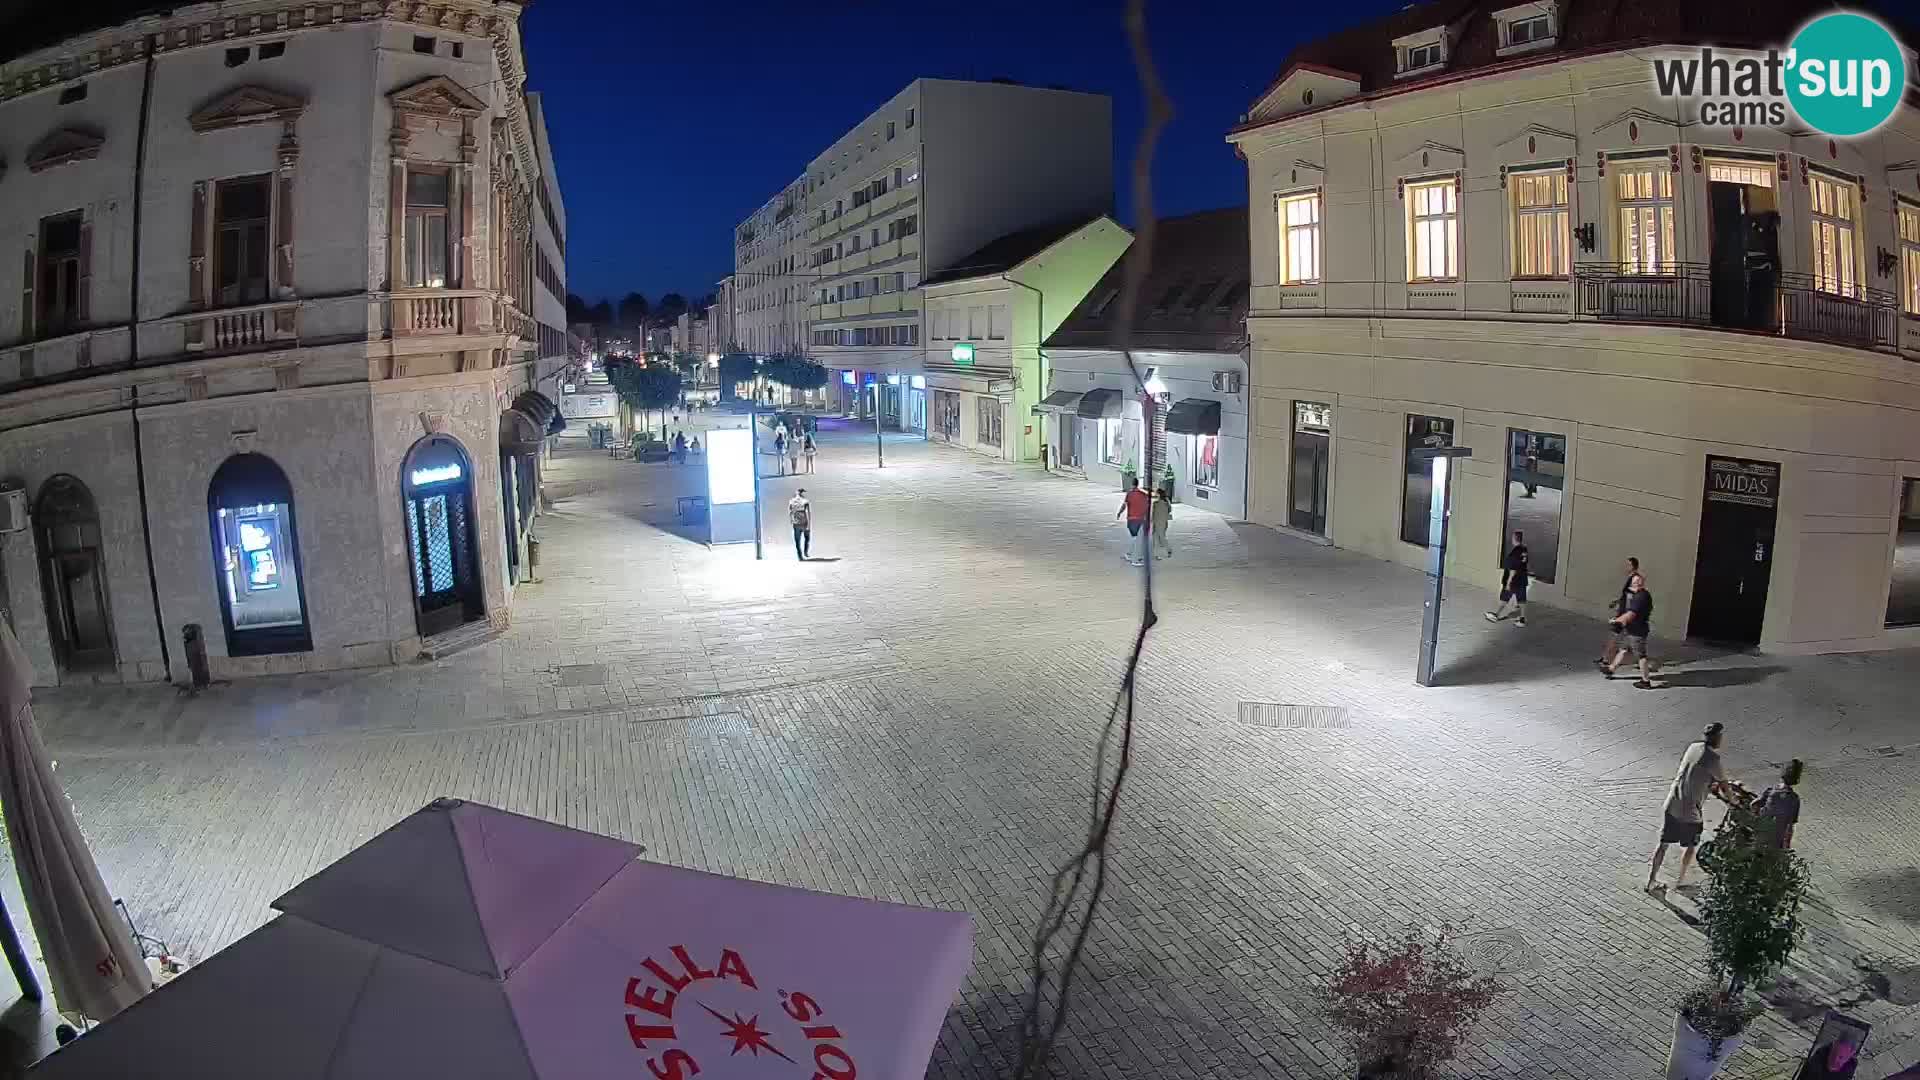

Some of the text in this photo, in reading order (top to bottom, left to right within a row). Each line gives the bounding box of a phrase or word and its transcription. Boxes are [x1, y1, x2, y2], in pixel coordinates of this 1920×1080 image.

[1715, 473, 1769, 495] MIDAS
[624, 944, 758, 1080] STELLA
[781, 991, 856, 1080] OIS
